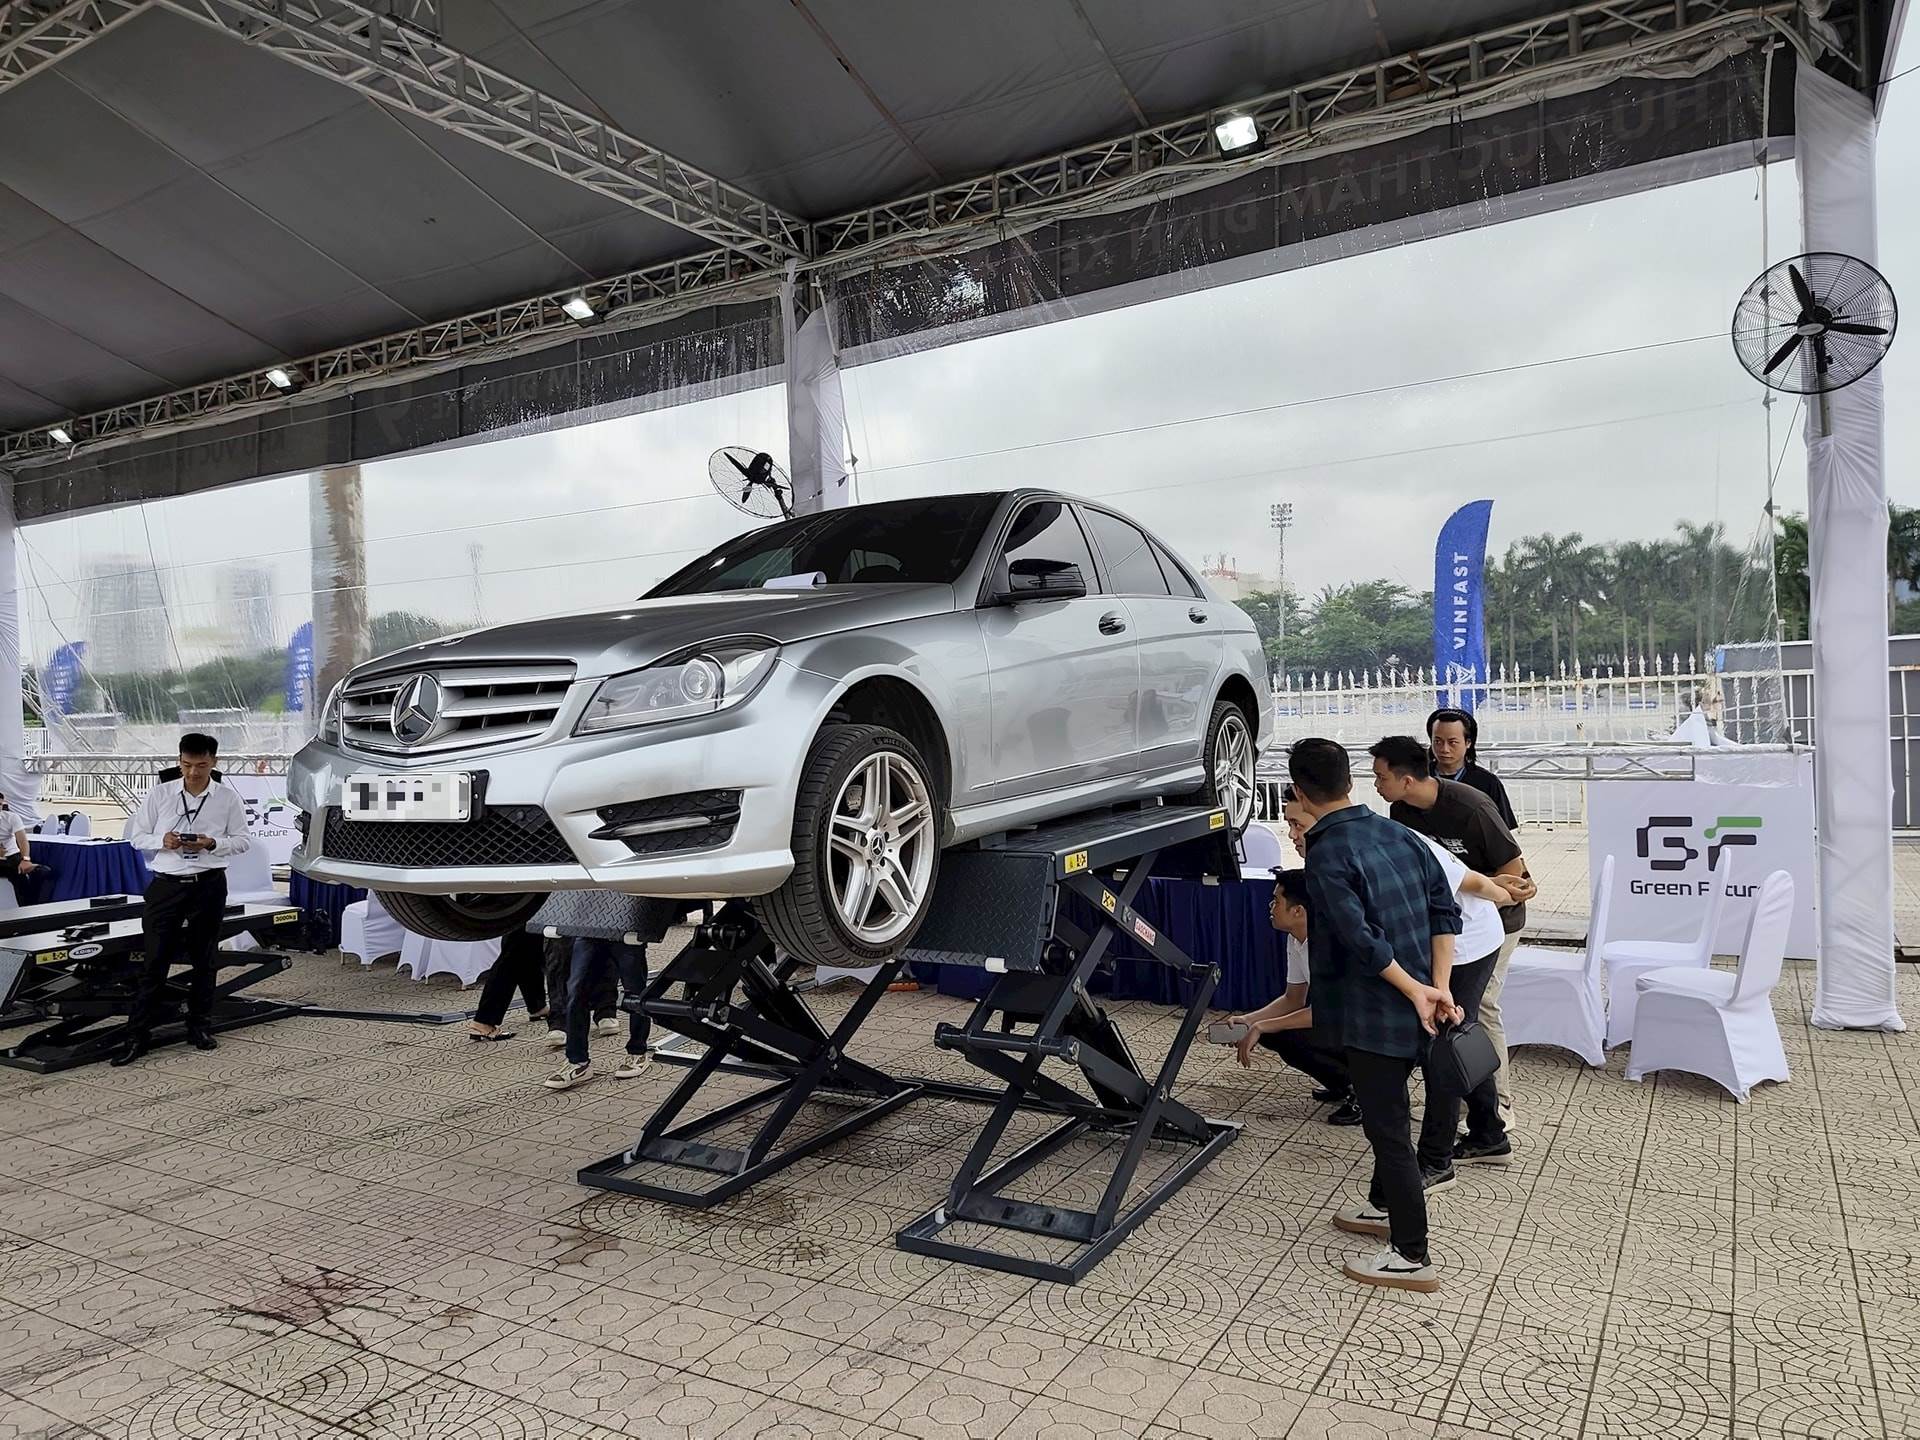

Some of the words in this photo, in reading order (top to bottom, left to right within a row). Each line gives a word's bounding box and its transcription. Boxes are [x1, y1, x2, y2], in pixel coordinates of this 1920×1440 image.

[1453, 552, 1469, 650] VINFAST
[258, 829, 289, 838] Future
[1630, 880, 1692, 896] Green
[1698, 881, 1760, 898] Ftur
